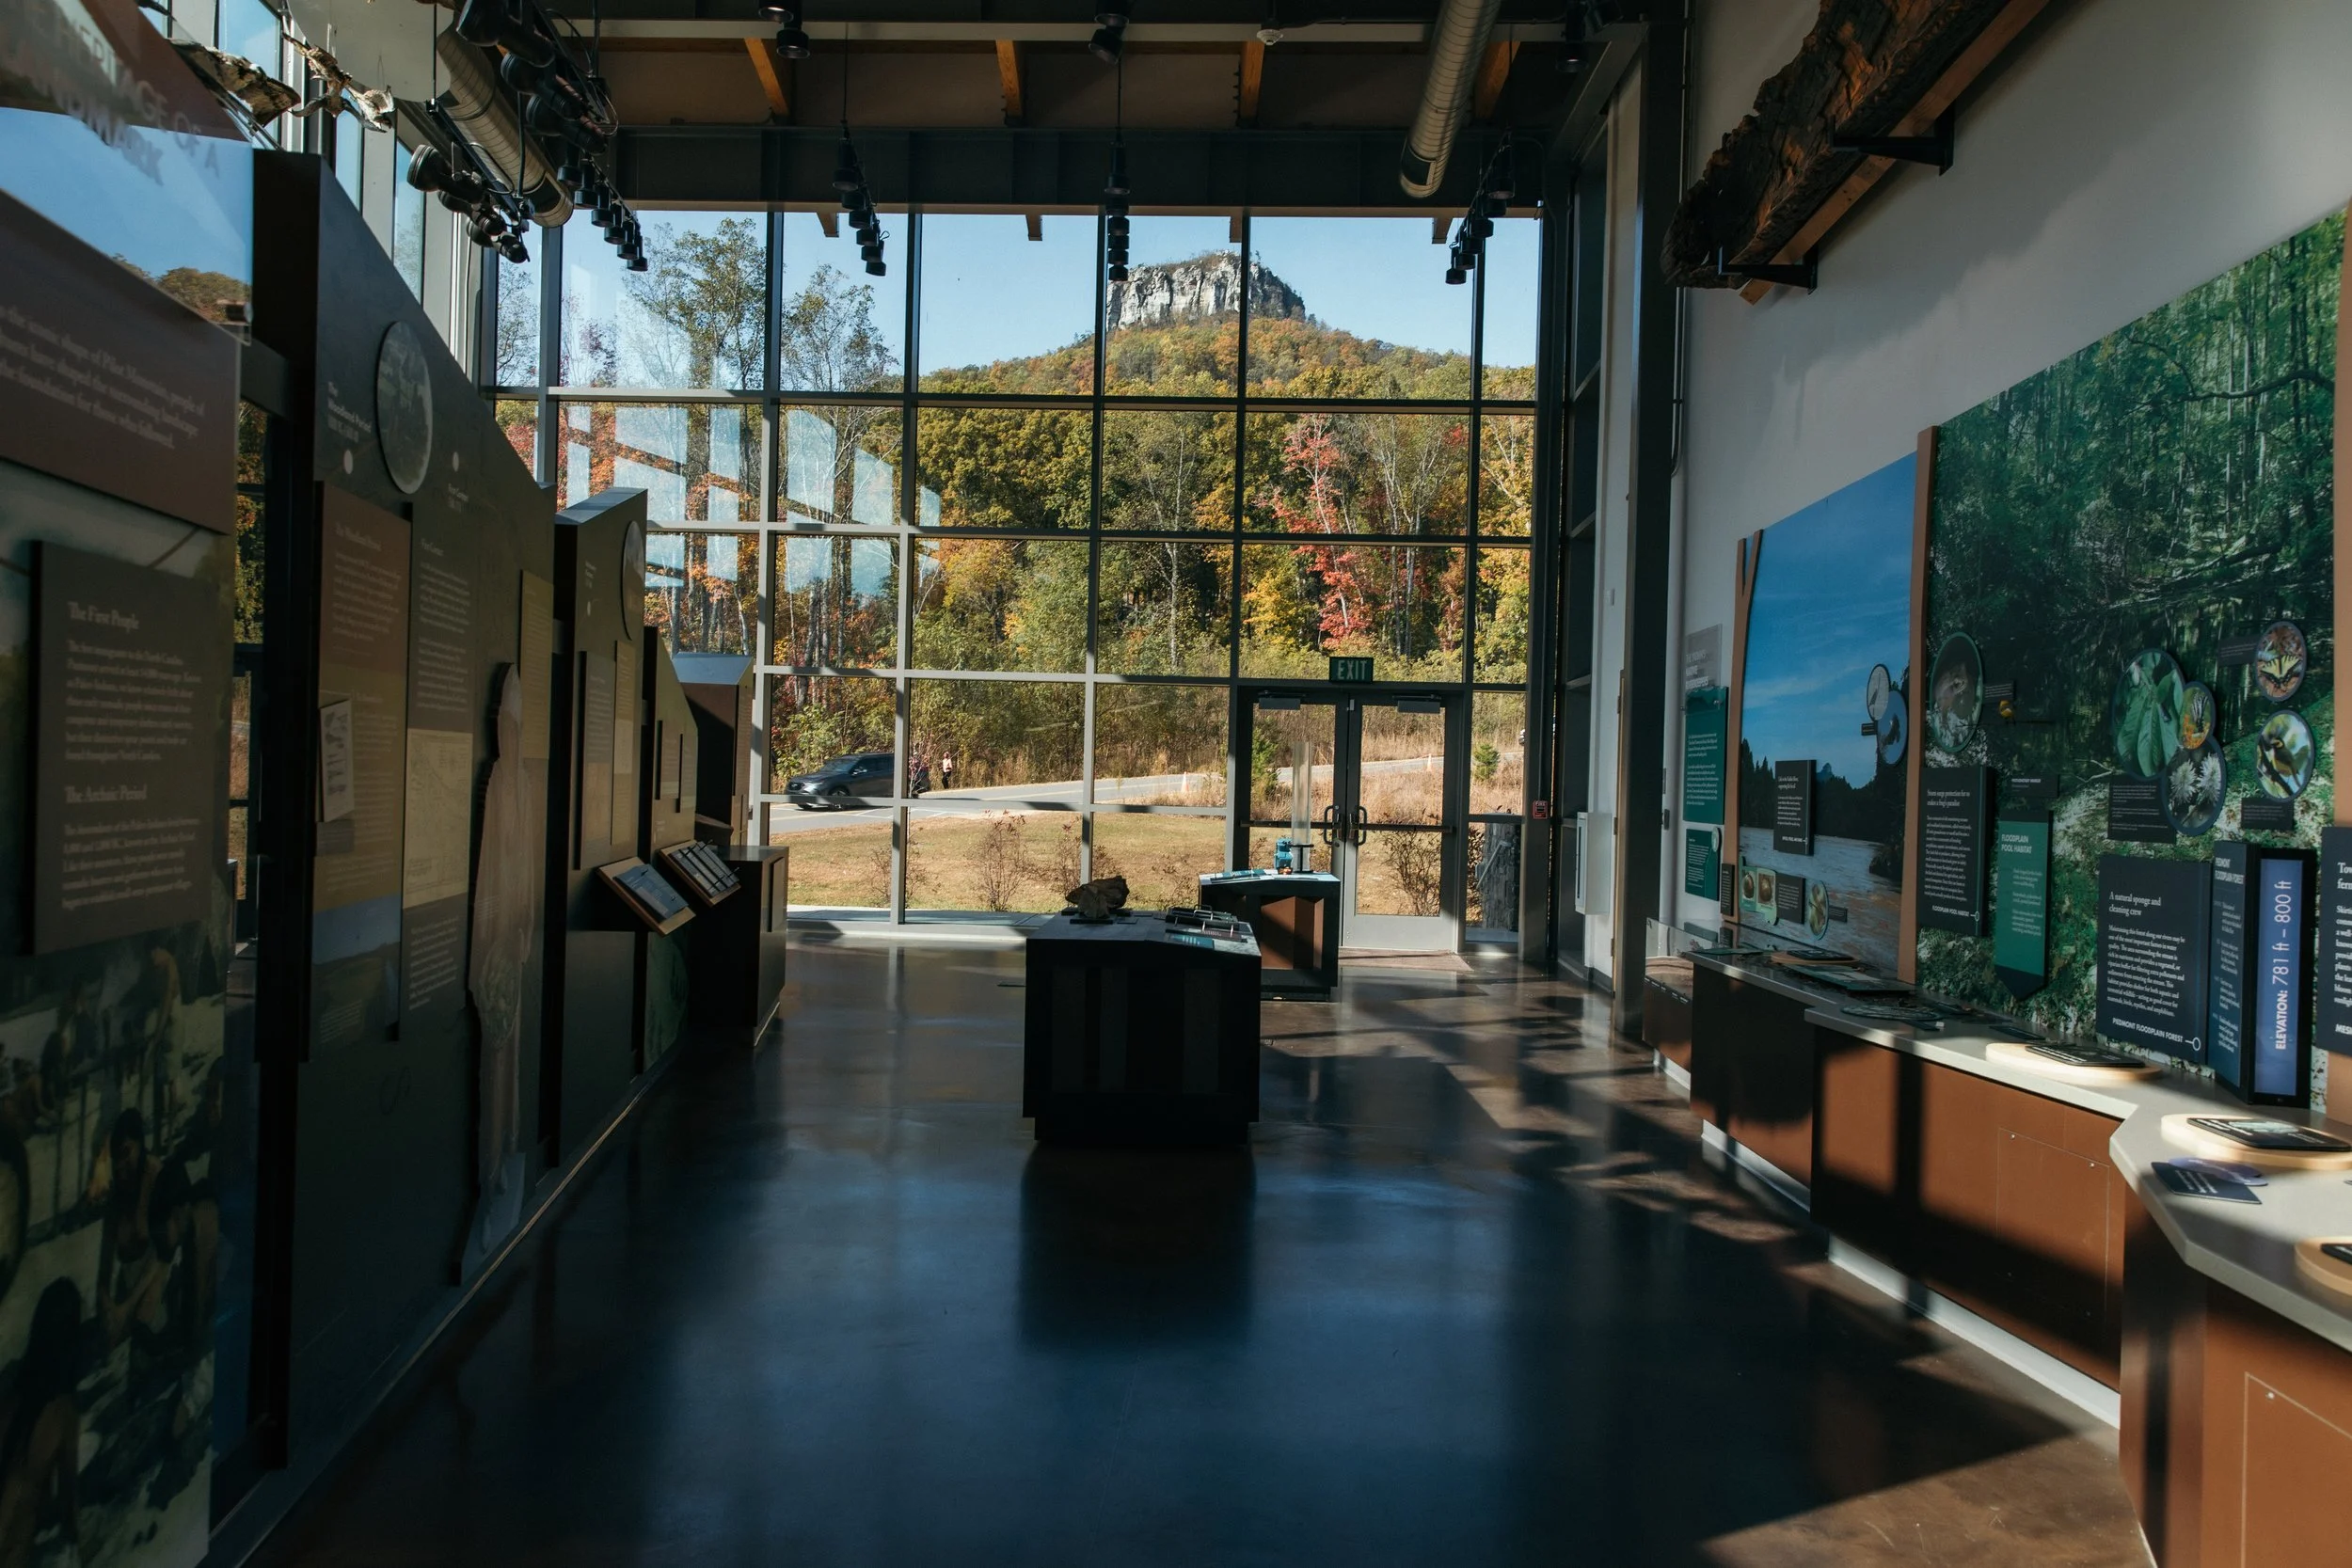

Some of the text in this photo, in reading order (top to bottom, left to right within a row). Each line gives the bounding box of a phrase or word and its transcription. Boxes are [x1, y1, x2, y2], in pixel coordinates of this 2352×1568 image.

[204, 142, 220, 180] A
[90, 348, 102, 366] of
[67, 600, 139, 635] The First People
[1337, 659, 1368, 680] EXIT
[63, 784, 84, 802] The
[119, 784, 147, 800] Period
[2001, 833, 2029, 844] FLOODPLAIN
[2001, 844, 2032, 854] POOL HABITAT
[2274, 880, 2292, 890] ft
[2108, 891, 2161, 907] A natural sponge and
[2108, 903, 2129, 916] cleaning
[2274, 895, 2292, 924] 800
[2272, 942, 2290, 952] ft
[2272, 958, 2289, 986] 781
[2275, 990, 2288, 1051] ELEVATION:
[2112, 1018, 2183, 1042] PIEDMONT FLOODPLAIN FOREST
